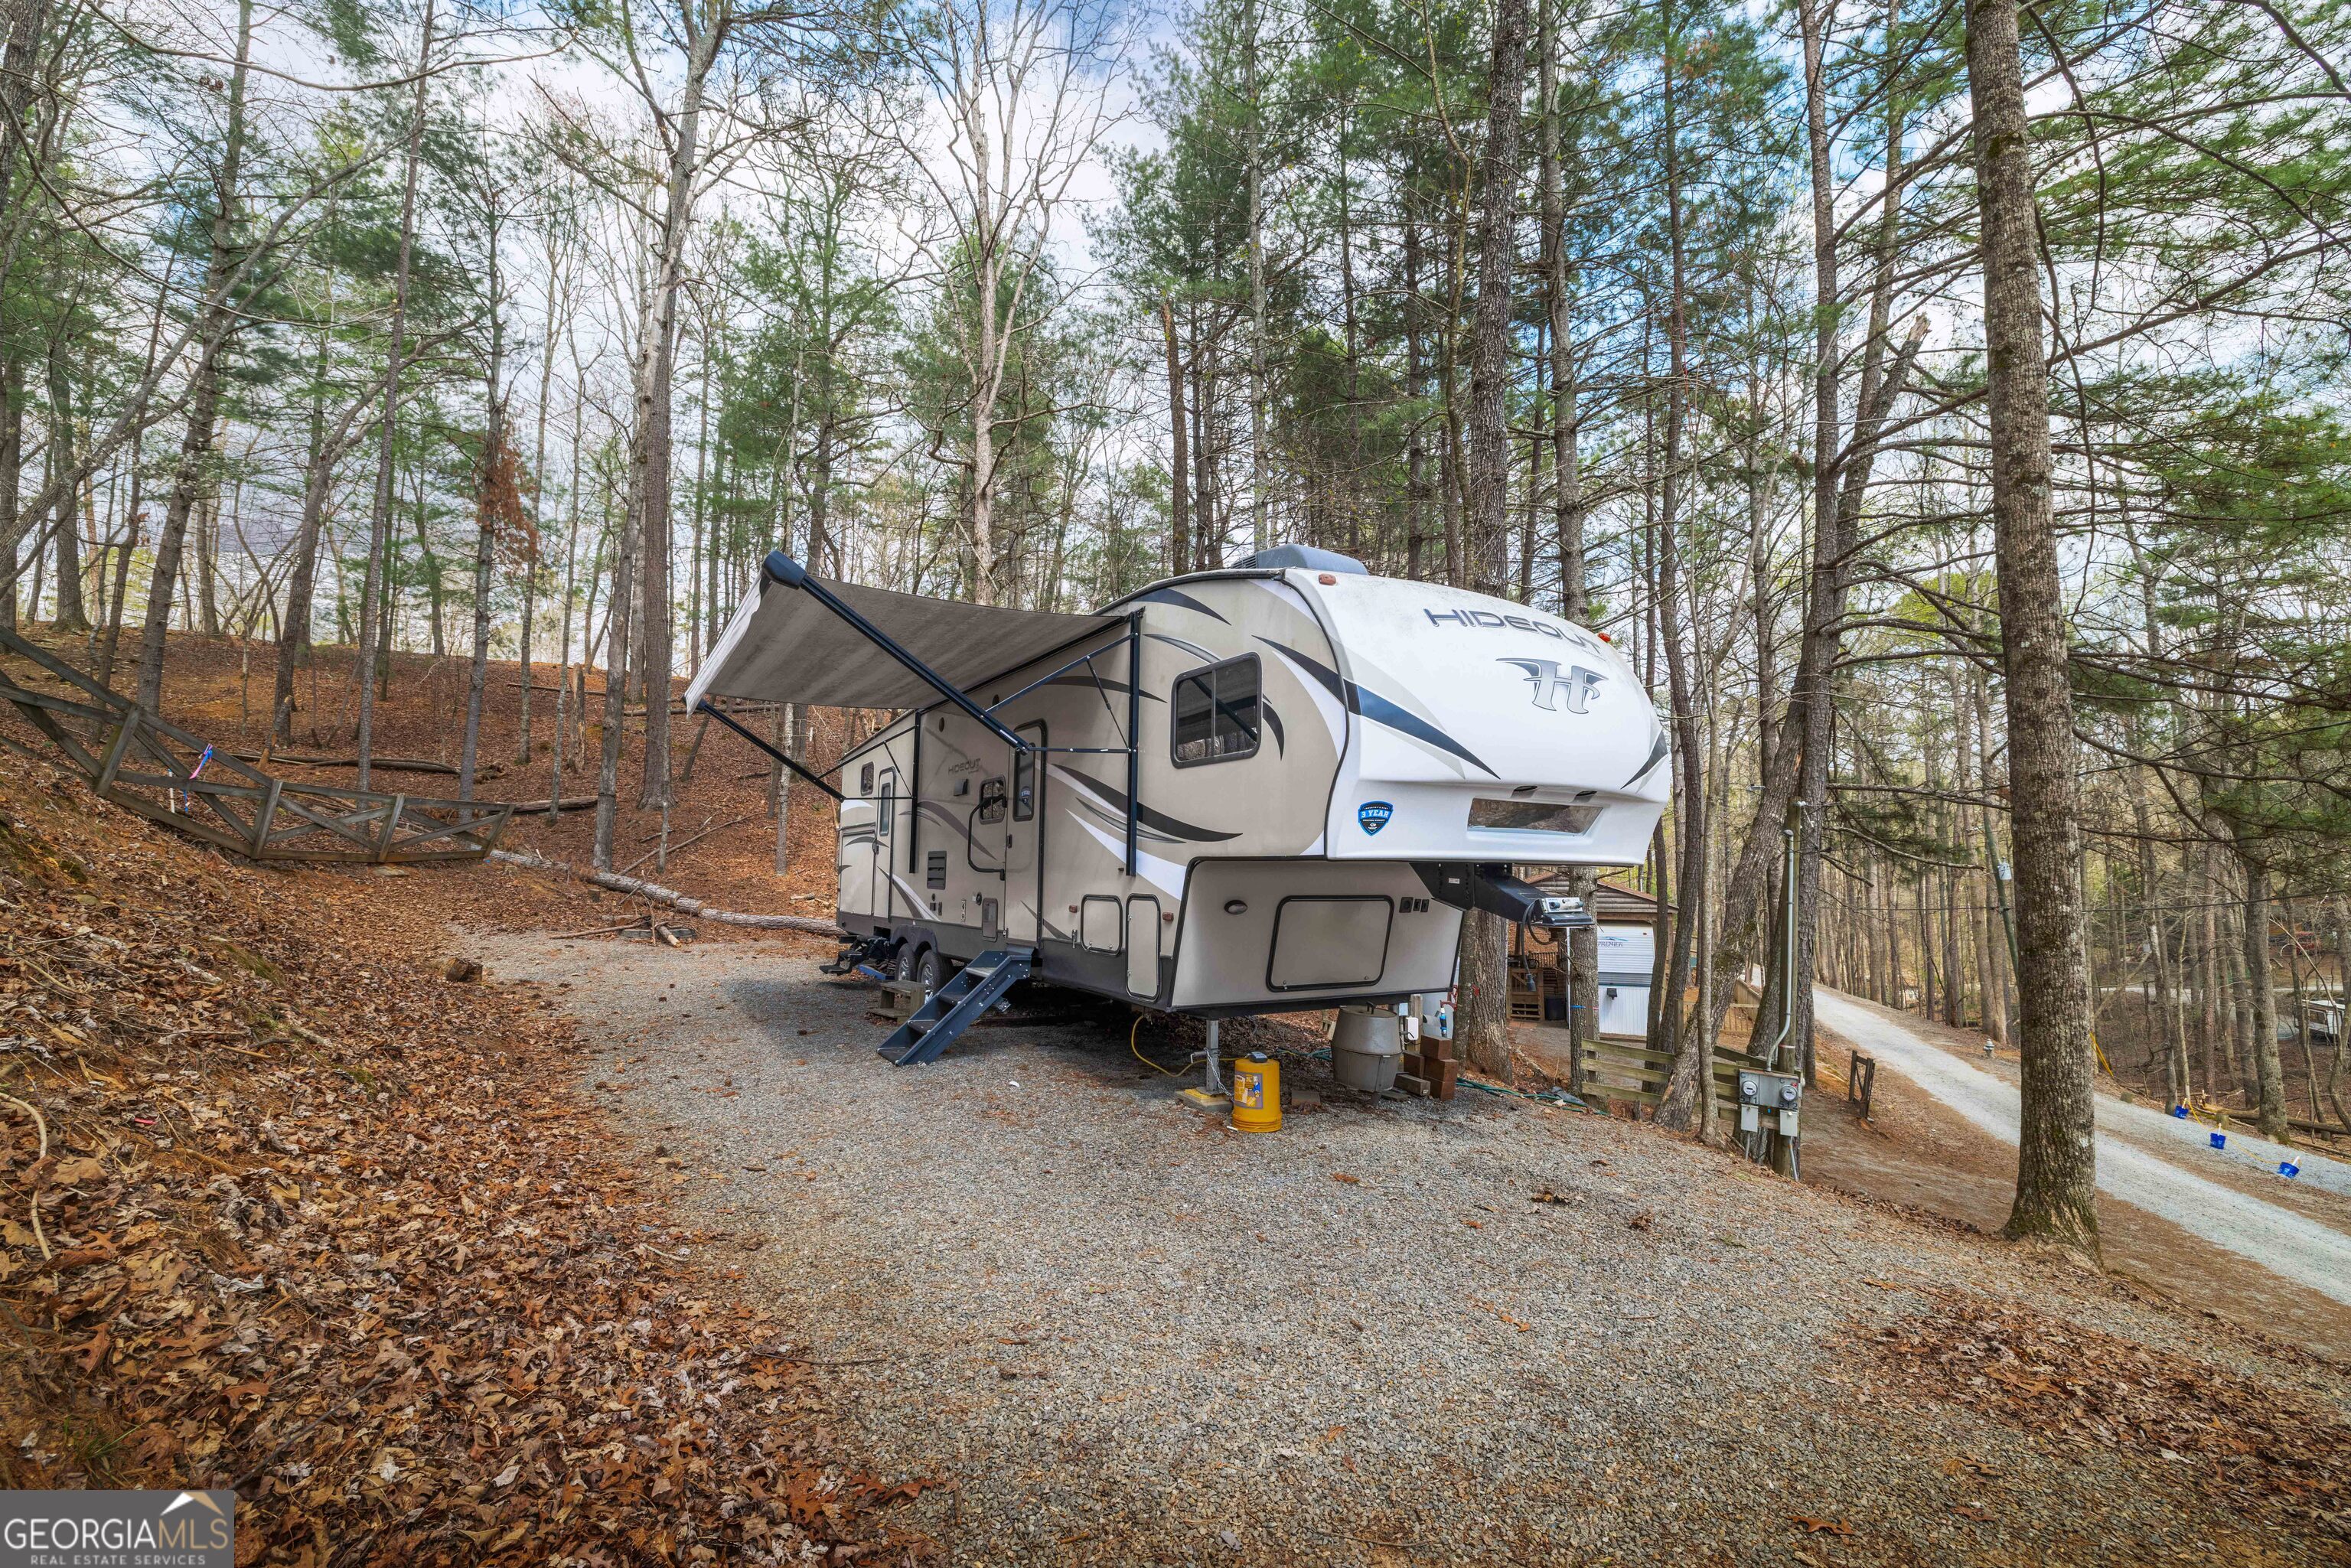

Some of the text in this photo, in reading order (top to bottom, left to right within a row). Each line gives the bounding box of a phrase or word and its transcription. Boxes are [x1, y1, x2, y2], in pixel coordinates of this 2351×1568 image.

[1423, 608, 1601, 654] HIDEOUT
[948, 758, 980, 773] HIDEOUT
[1740, 1095, 1757, 1103] 511
[1779, 1102, 1798, 1111] 512
